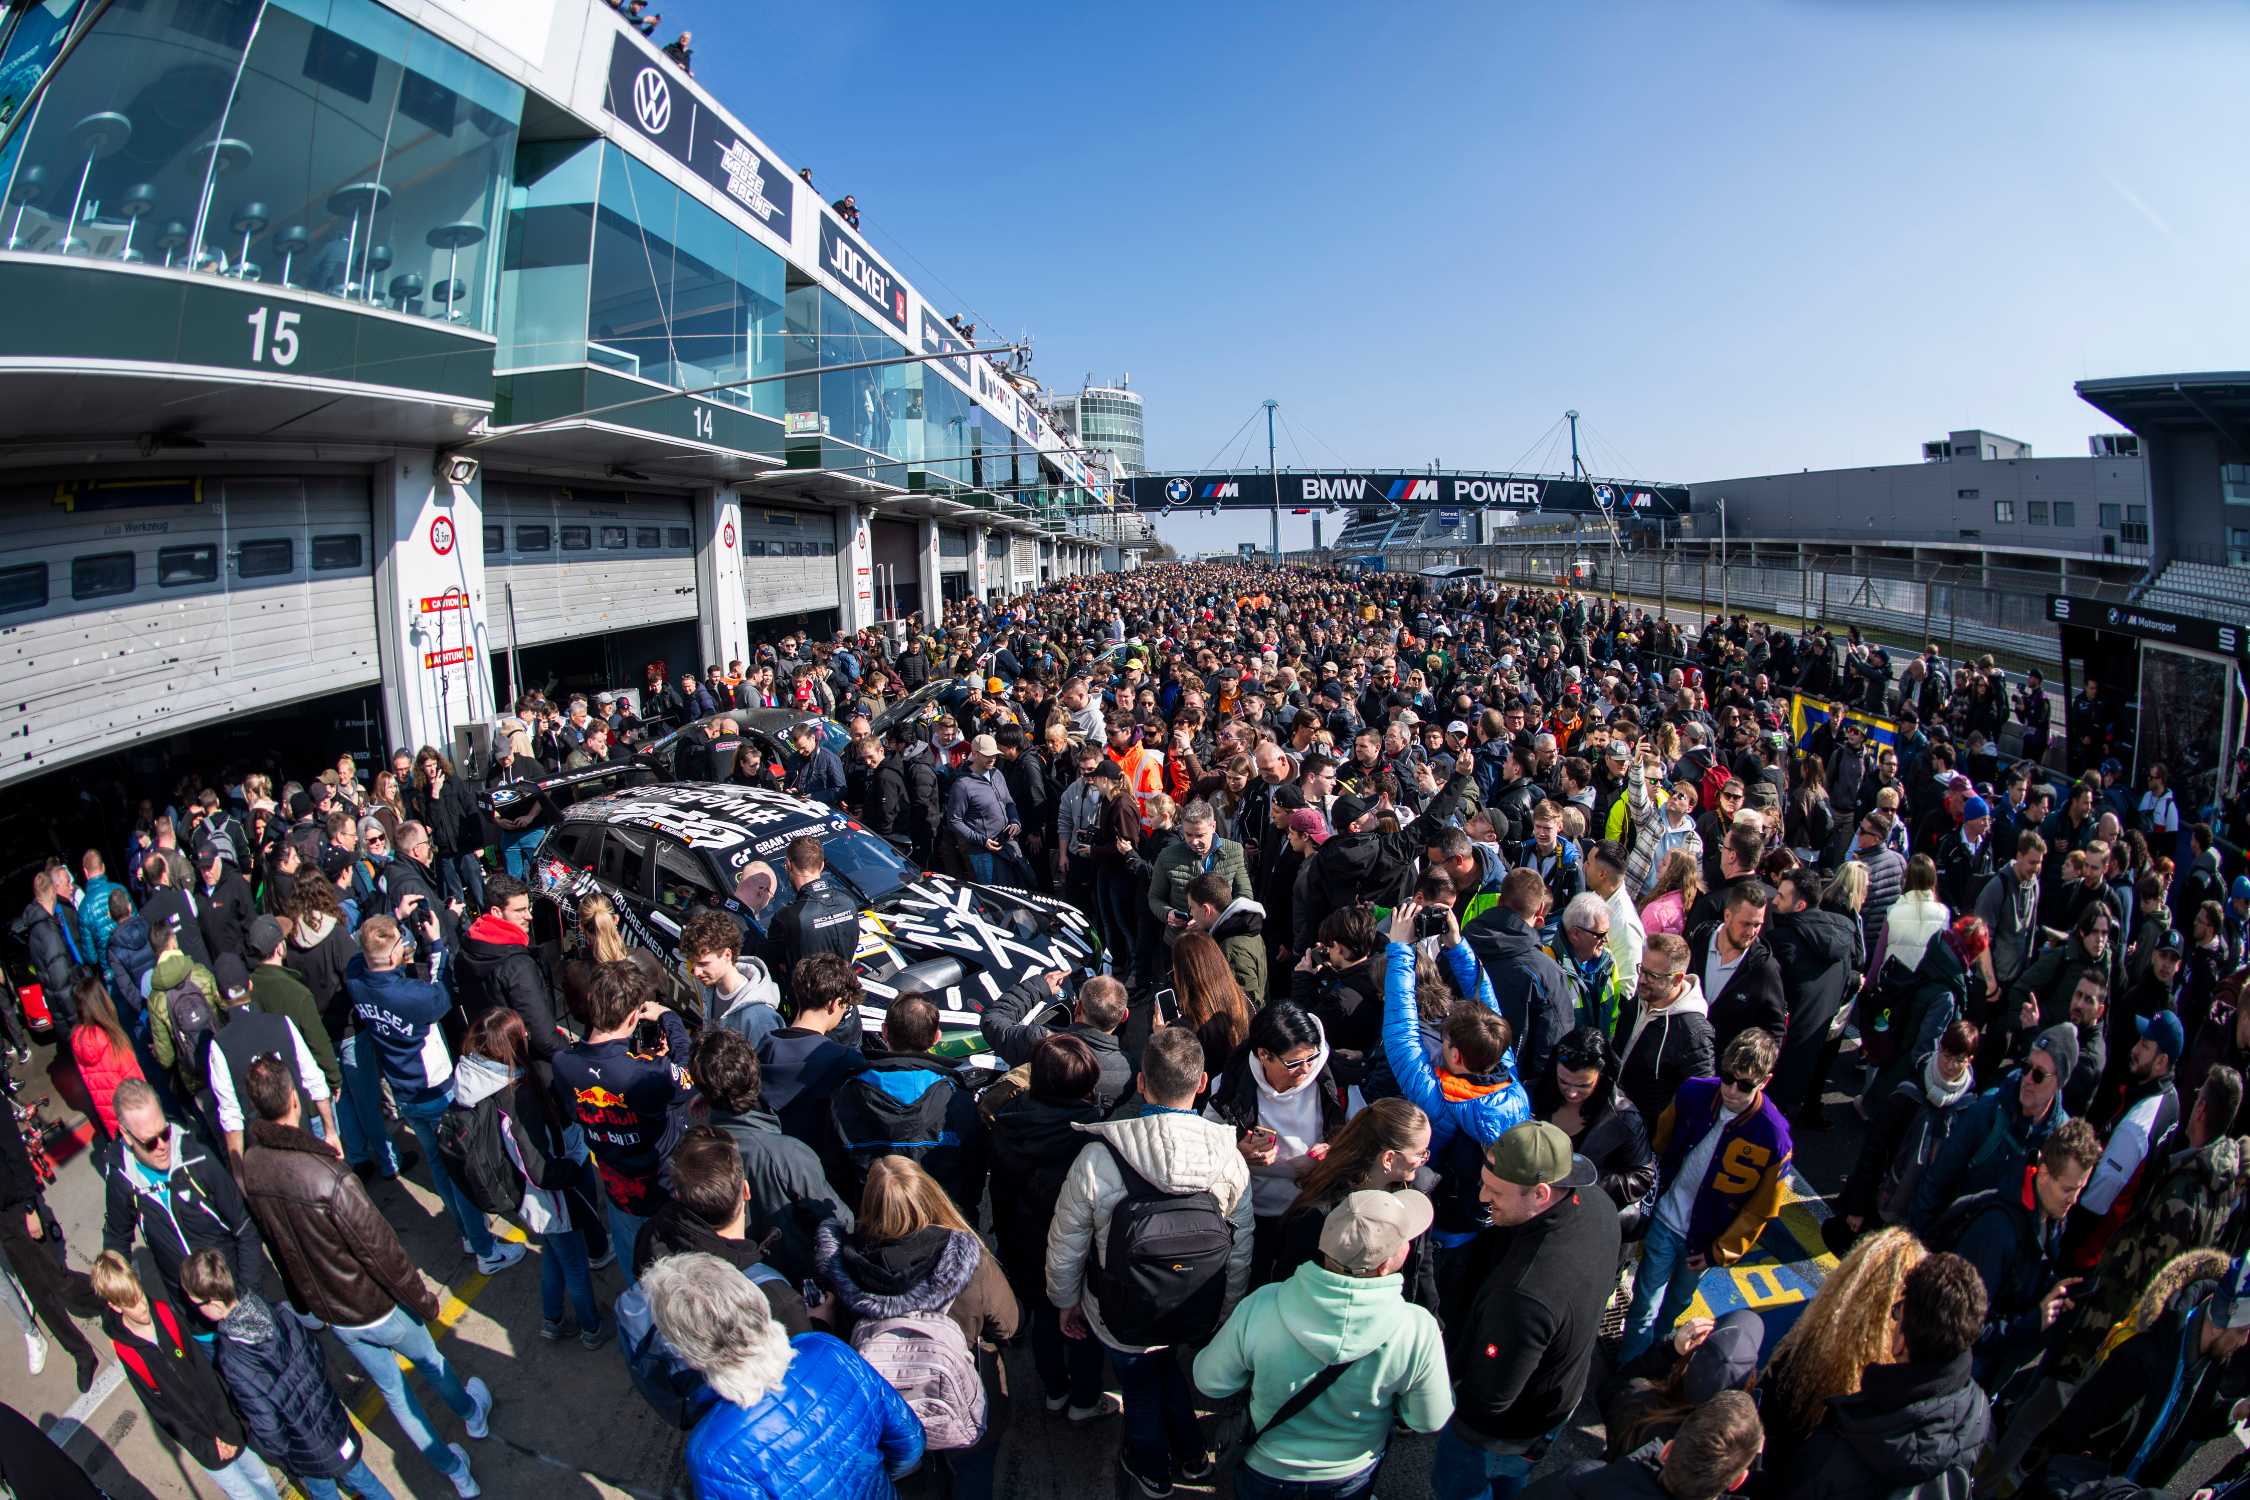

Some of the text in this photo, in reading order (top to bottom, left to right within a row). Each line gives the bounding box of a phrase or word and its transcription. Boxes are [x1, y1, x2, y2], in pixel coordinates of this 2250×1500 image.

[727, 174, 772, 221] RACING
[247, 307, 301, 367] 15
[694, 406, 713, 439] 14
[1302, 479, 1367, 500] BMW
[1454, 481, 1539, 504] POWER
[2138, 616, 2177, 634] Motorsport
[755, 835, 784, 853] GRAN
[611, 889, 626, 912] YOU
[625, 909, 664, 959] DREAMED
[354, 1003, 414, 1037] HELSEA
[376, 1021, 391, 1036] FC
[588, 1128, 625, 1146] Mobil
[1713, 1138, 1770, 1196] S
